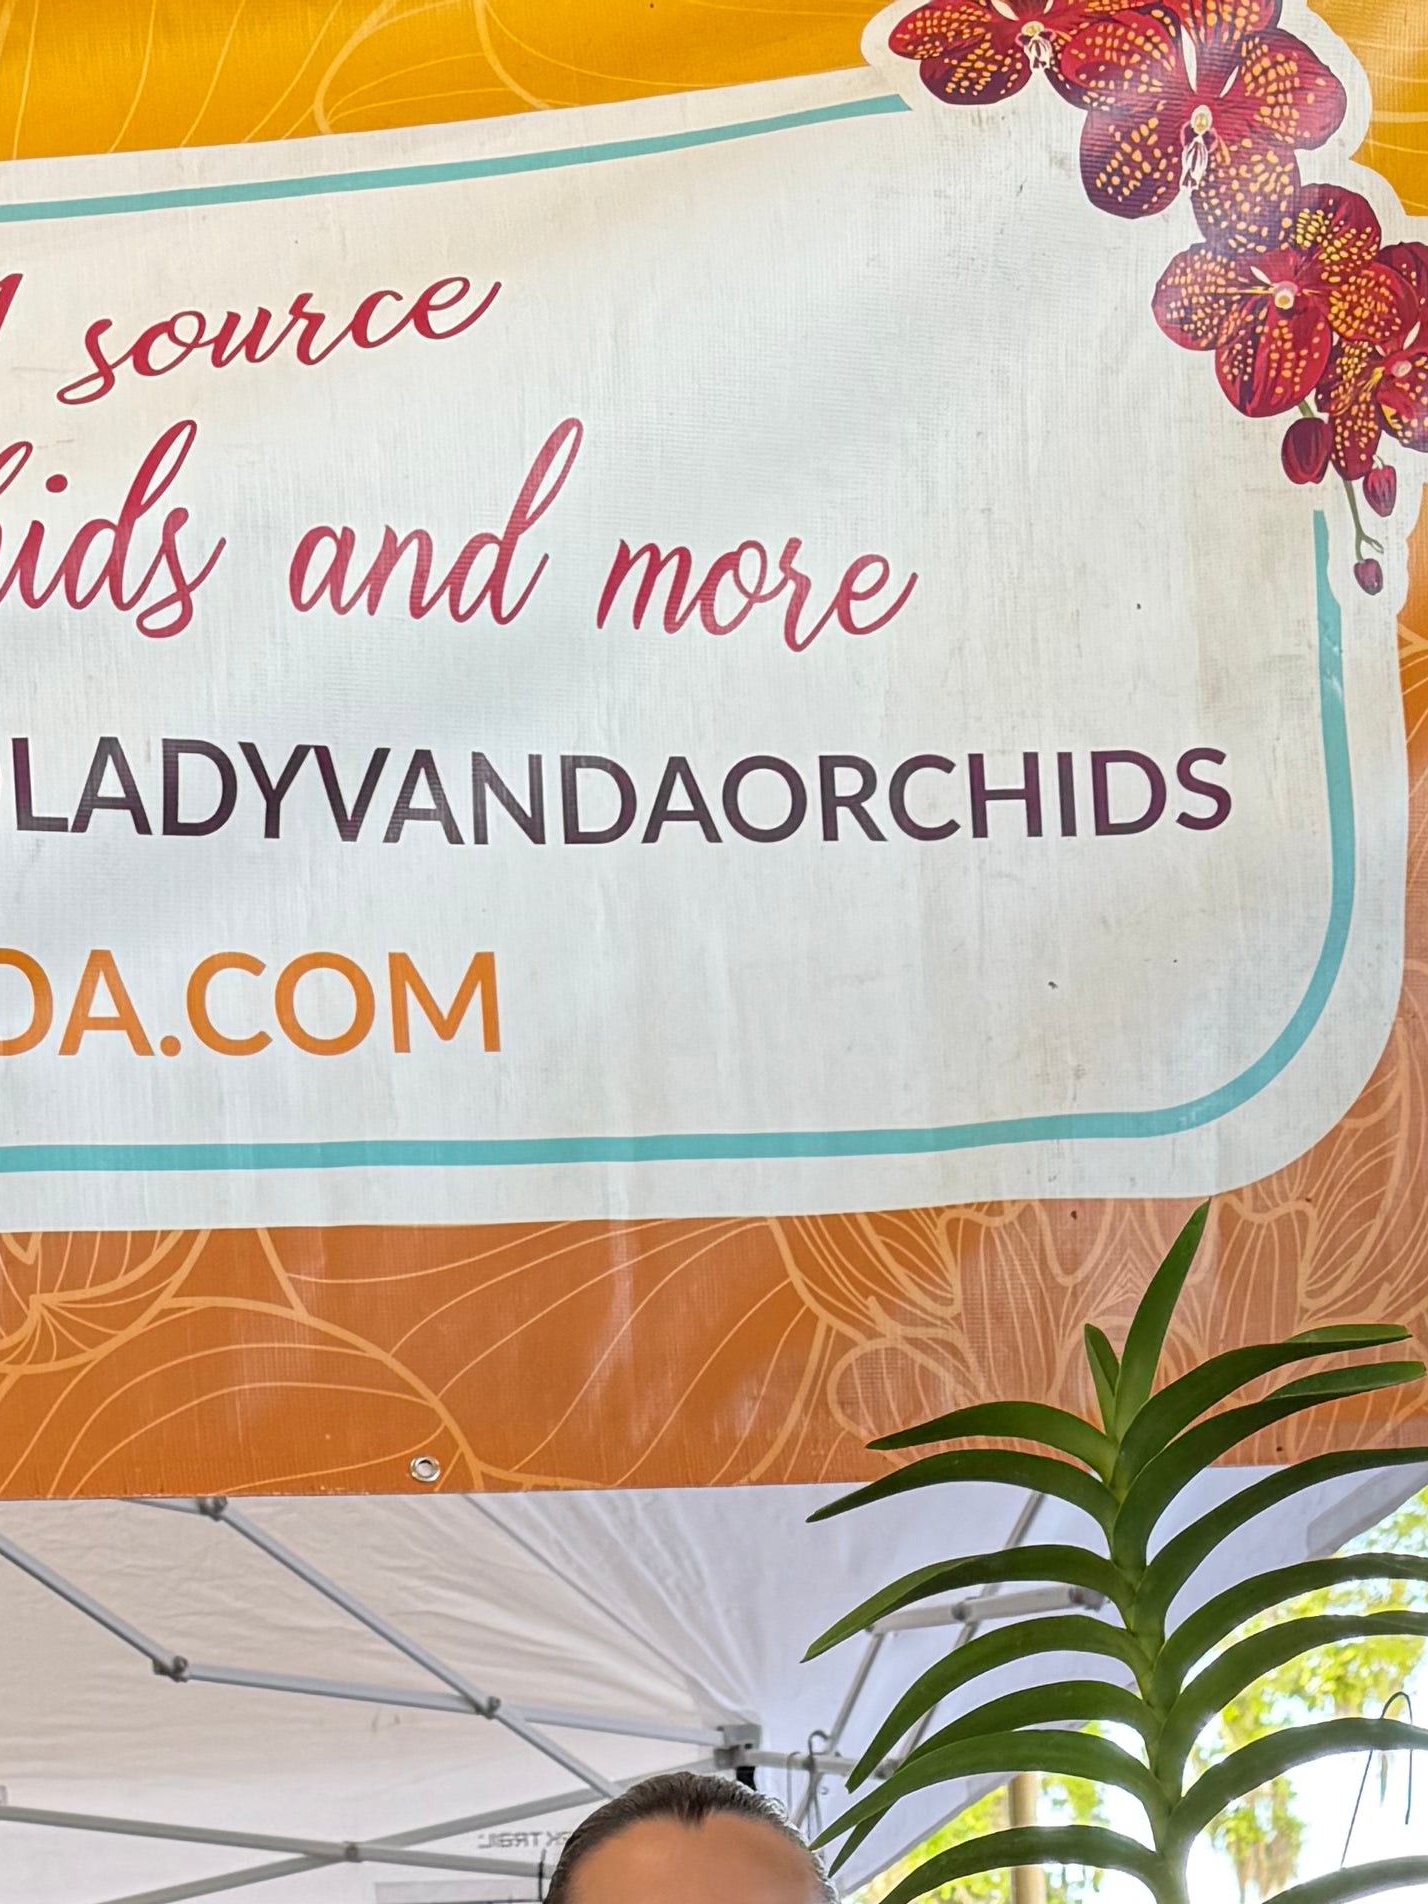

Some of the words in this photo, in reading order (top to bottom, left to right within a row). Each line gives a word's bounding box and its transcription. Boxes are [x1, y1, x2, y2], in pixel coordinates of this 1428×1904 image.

[56, 276, 502, 406] source
[288, 417, 581, 627] and
[596, 537, 919, 653] more
